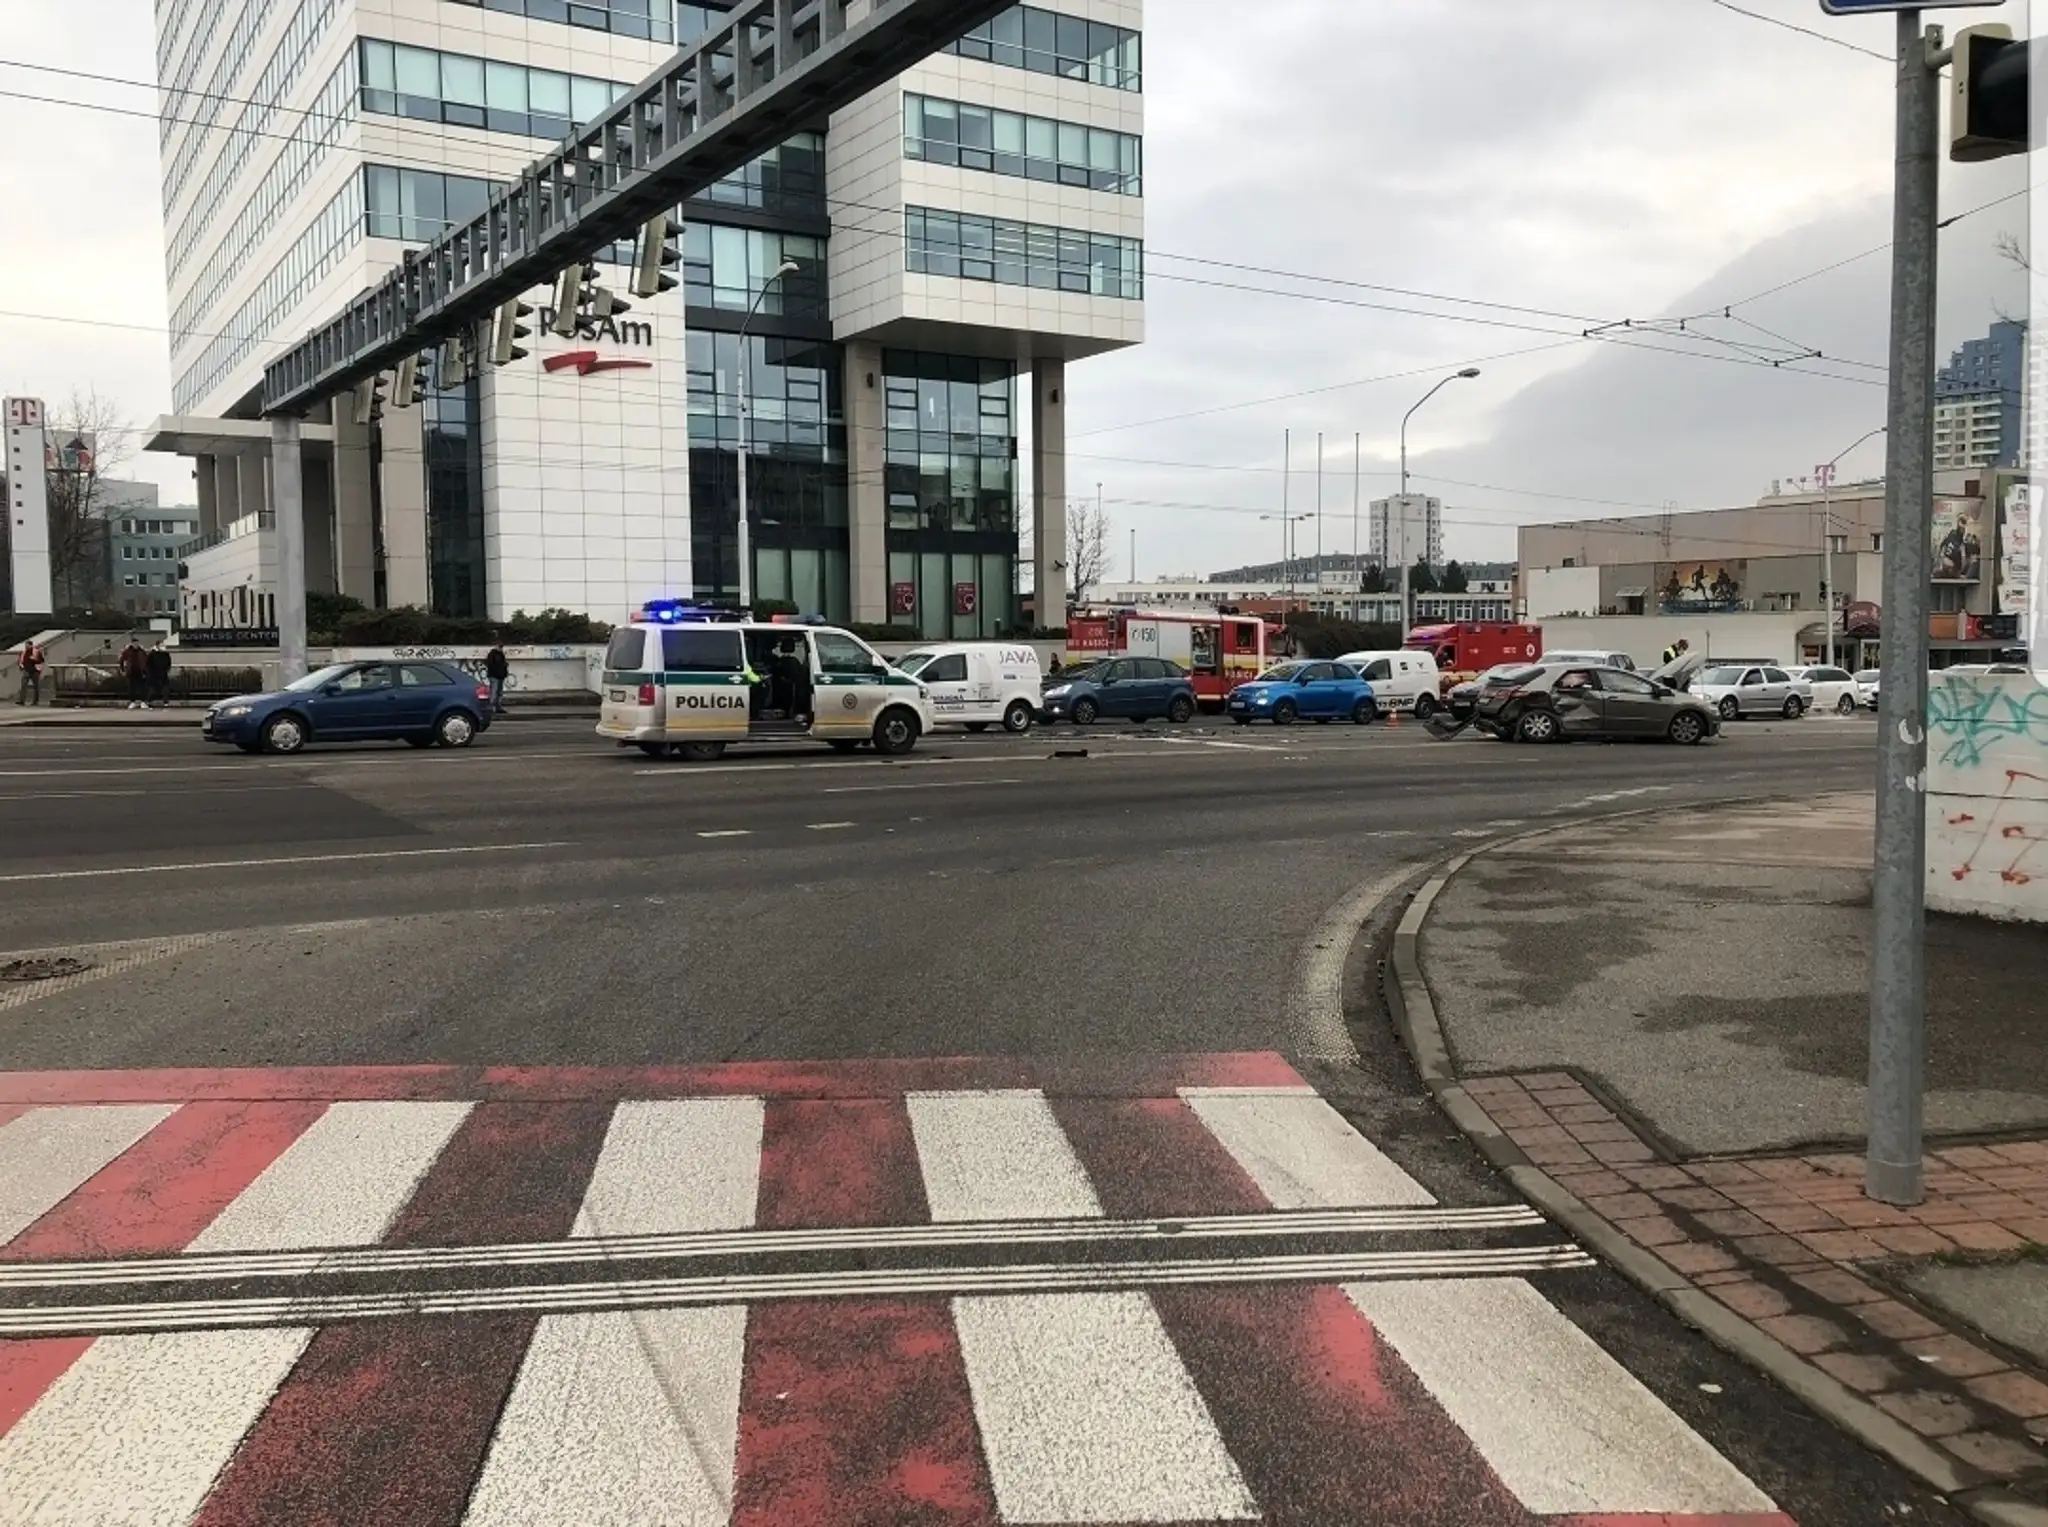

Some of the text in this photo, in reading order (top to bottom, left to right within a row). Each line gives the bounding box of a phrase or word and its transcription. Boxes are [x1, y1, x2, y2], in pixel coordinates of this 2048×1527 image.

[539, 307, 652, 346] PsAm
[181, 586, 279, 629] FORUM
[1000, 650, 1037, 665] JAVA
[676, 692, 745, 708] POLÍCIA
